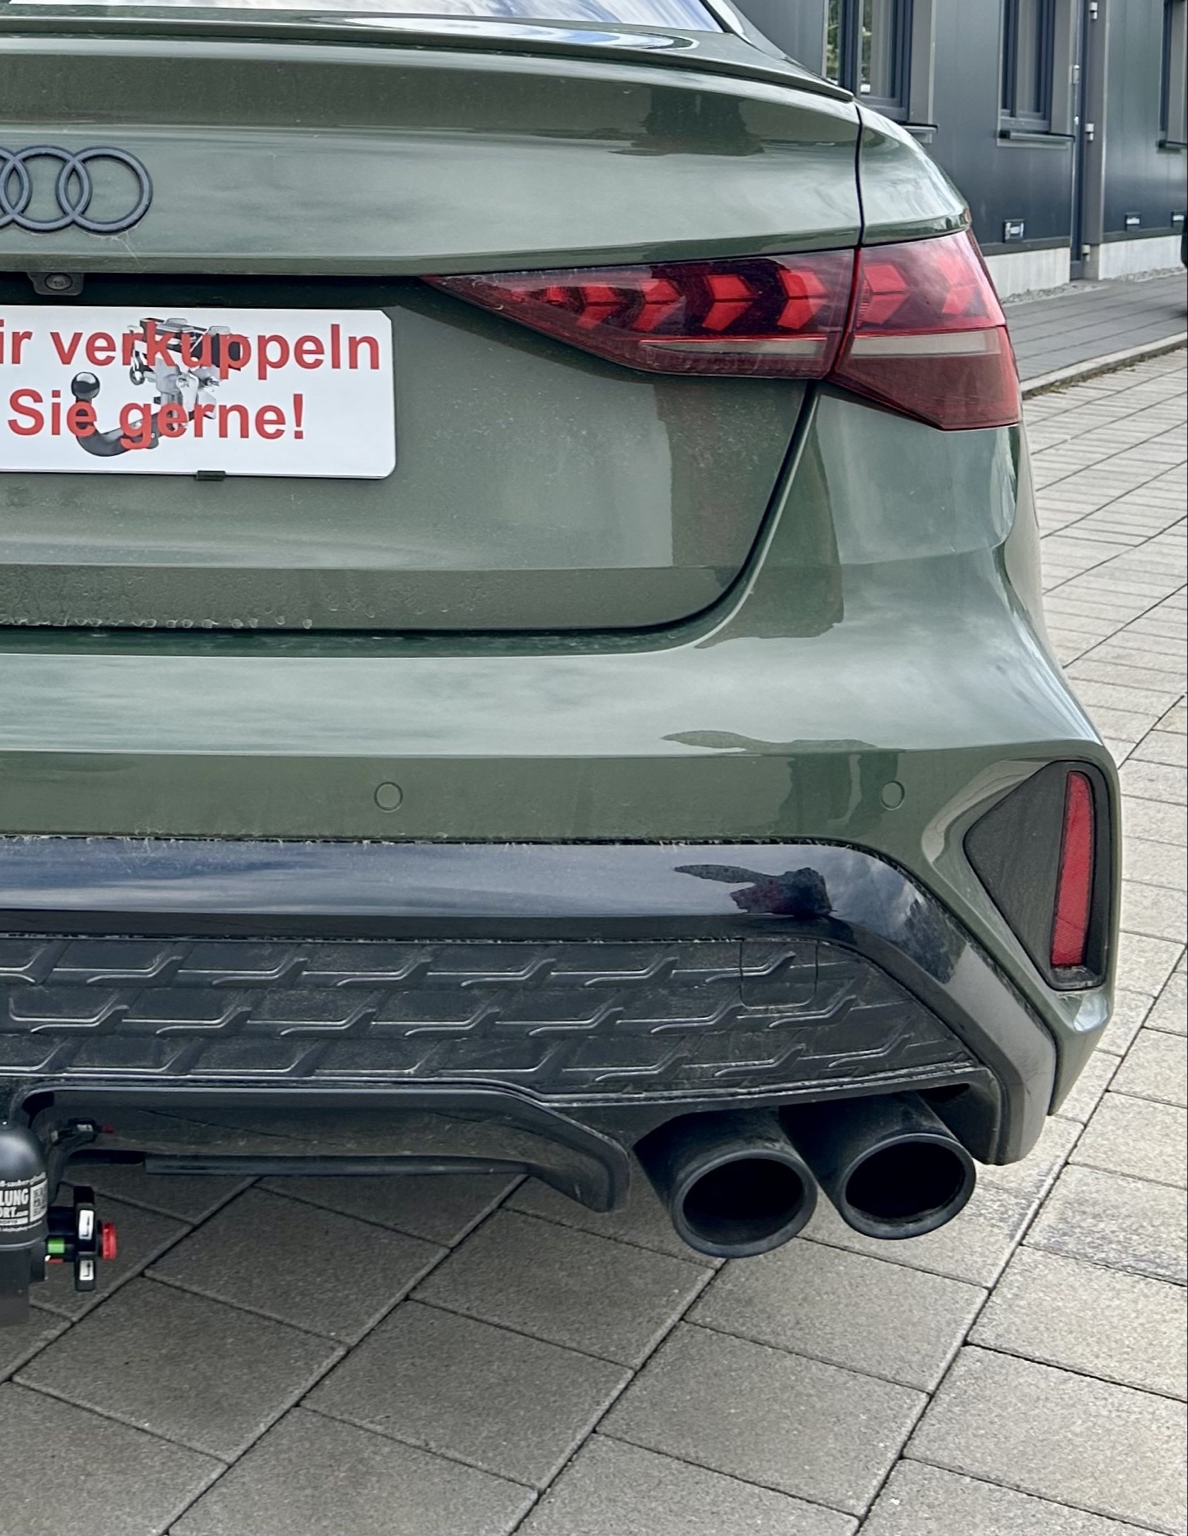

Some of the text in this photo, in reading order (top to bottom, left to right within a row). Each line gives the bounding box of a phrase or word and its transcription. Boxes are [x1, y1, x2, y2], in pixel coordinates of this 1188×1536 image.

[49, 322, 381, 380] verkuppeln
[7, 388, 304, 451] Sie gerne!
